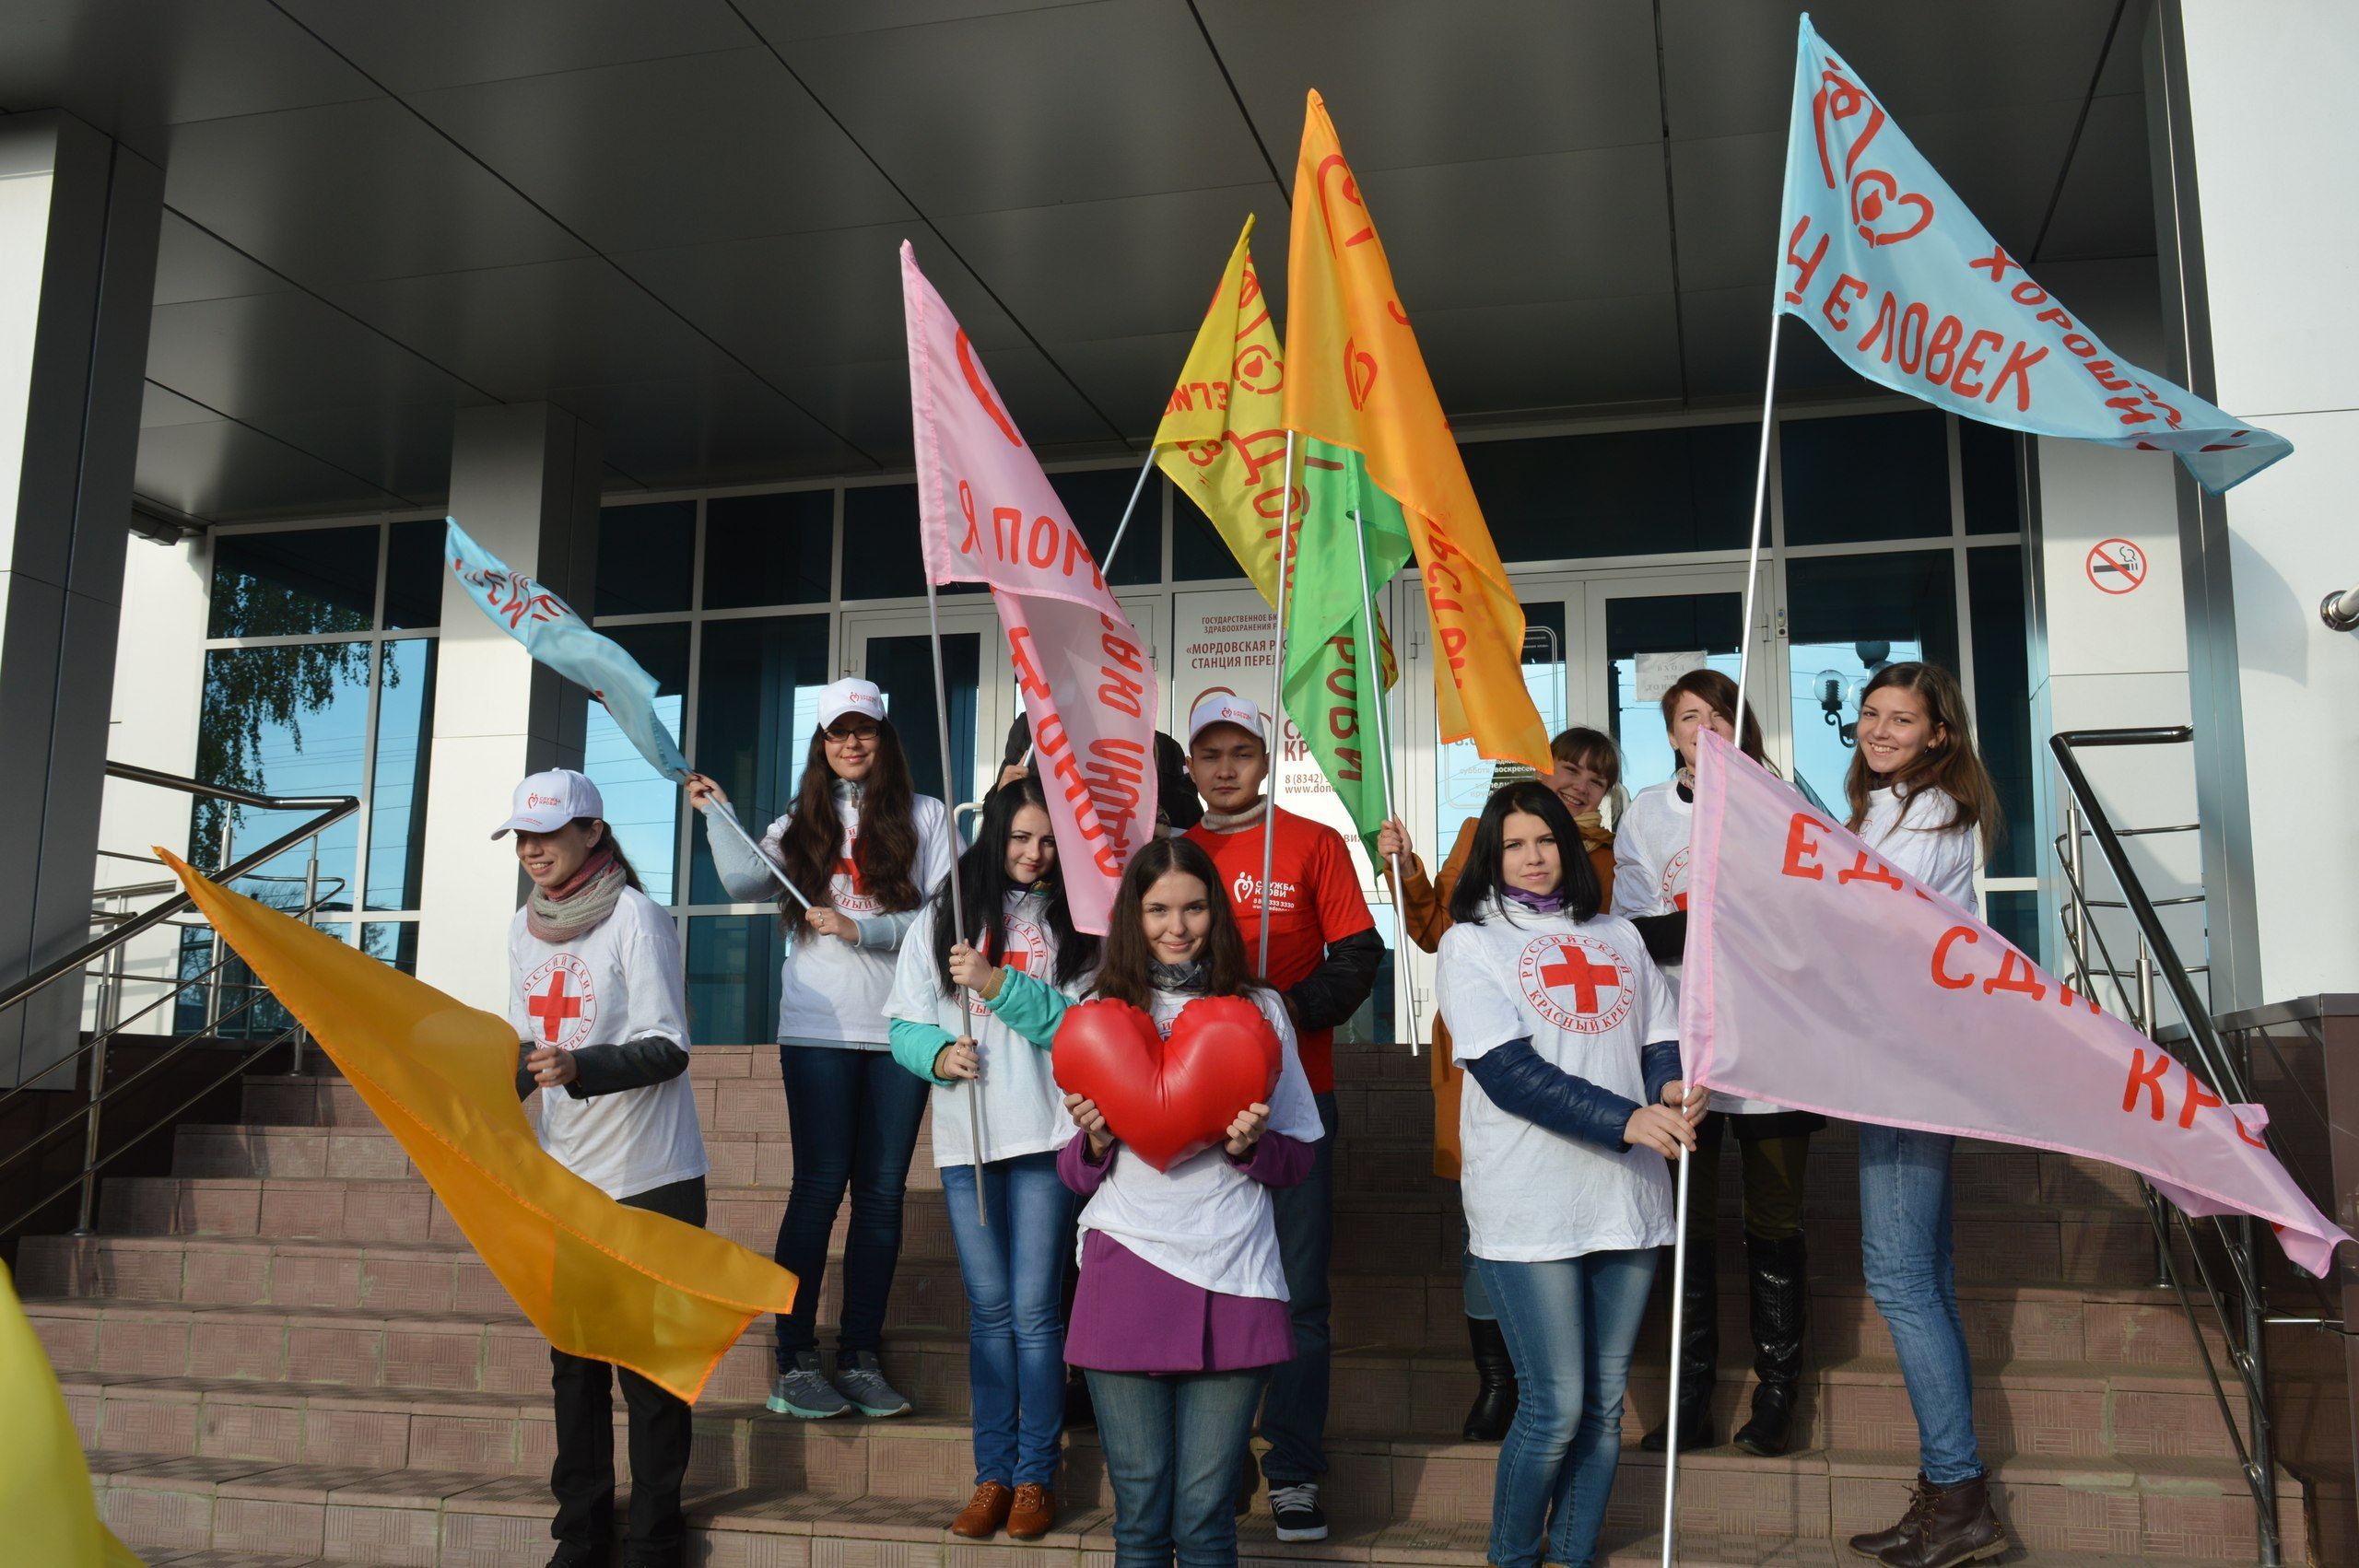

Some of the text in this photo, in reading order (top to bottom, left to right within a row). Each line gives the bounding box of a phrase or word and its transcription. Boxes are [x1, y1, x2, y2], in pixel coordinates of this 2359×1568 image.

[1784, 216, 2048, 412] ЧЕЛОВЕК
[1969, 245, 2159, 440] ХОРОШИ
[1202, 614, 1267, 625] ГОСУДАРСТВЕННОЕ
[1203, 624, 1272, 634] ЗДРАВООХРАНЕНИЯ
[1186, 640, 1266, 655] «МОРДОВСКАЯ
[1191, 656, 1241, 670] СТАНЦИЯ
[1293, 774, 1323, 785] (8342)
[1254, 887, 1287, 898] КОВИ
[1255, 881, 1296, 893] СУЖБА
[1521, 935, 1632, 978] РОССИЙСКИЙ
[523, 955, 595, 1002] ОССИЙСКИЙ
[1530, 986, 1634, 1032] КРАСНЫЙ КРЕСТ
